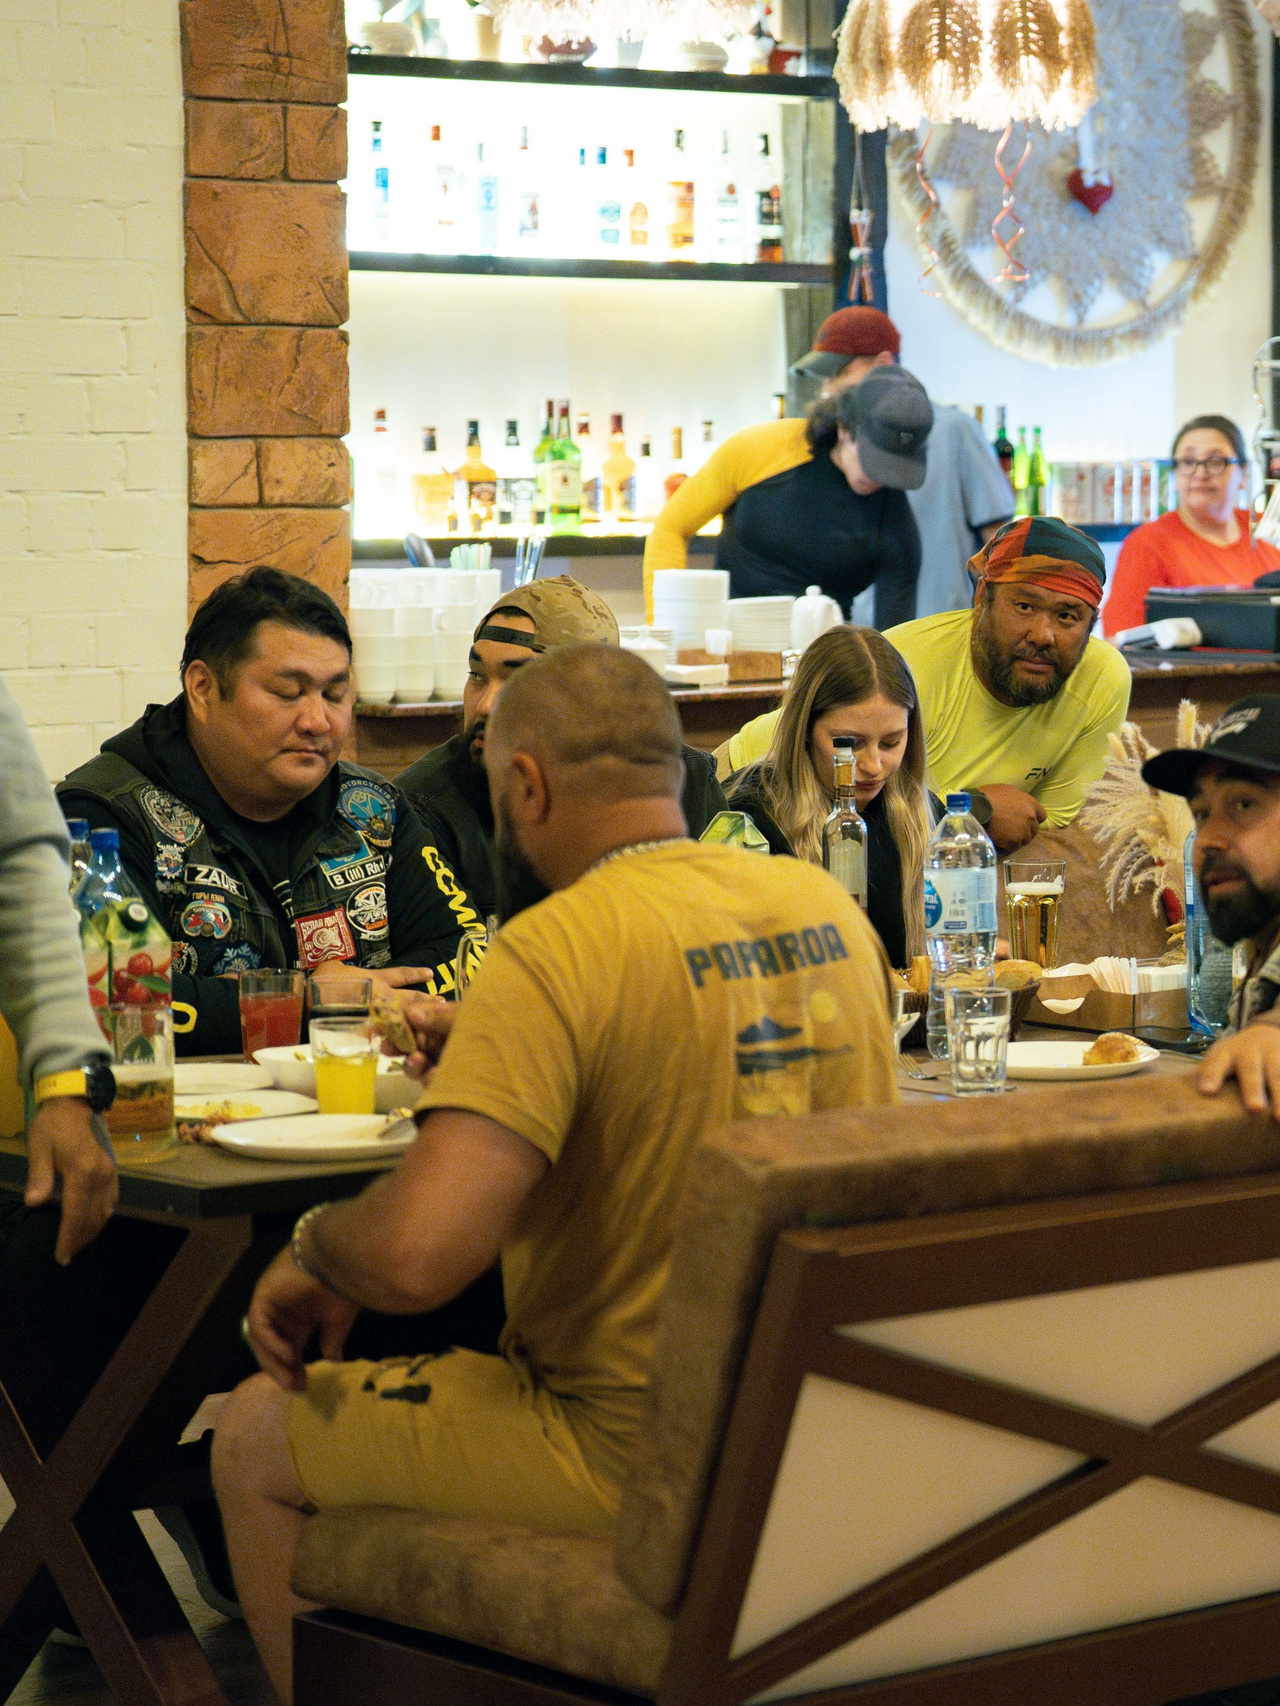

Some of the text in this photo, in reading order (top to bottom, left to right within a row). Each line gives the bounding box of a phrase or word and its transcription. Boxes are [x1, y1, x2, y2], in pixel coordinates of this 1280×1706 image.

[194, 867, 237, 892] ZAUR
[333, 874, 344, 886] B
[345, 865, 365, 883] (III)
